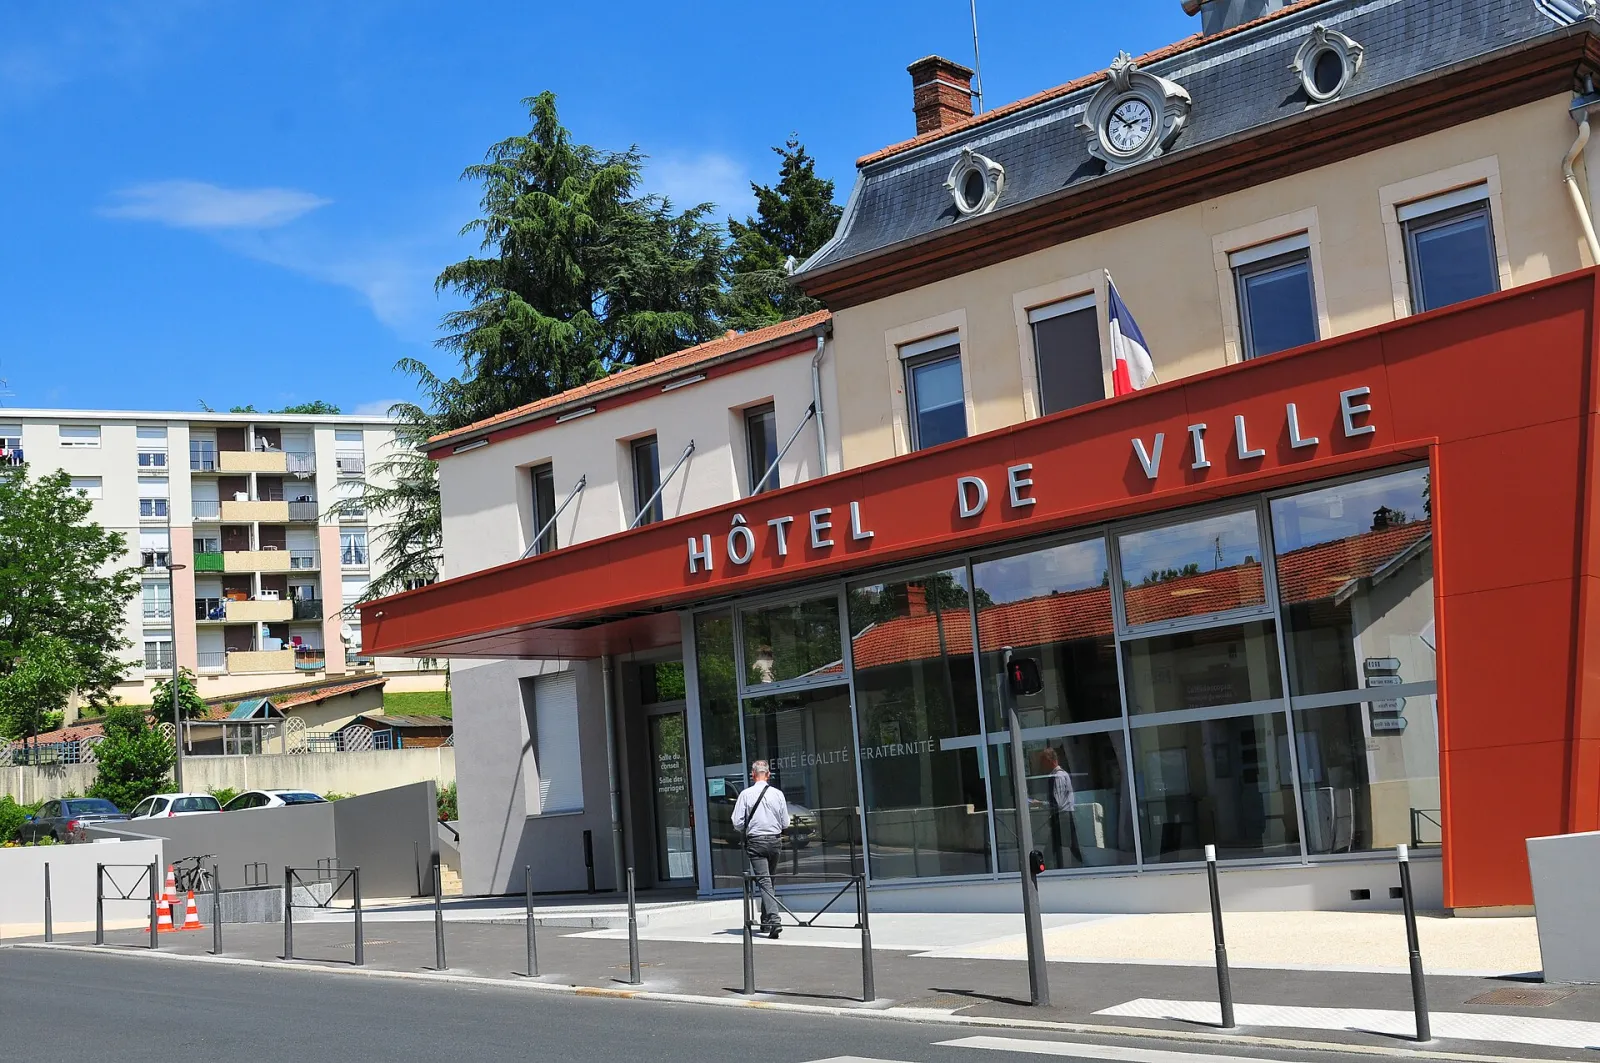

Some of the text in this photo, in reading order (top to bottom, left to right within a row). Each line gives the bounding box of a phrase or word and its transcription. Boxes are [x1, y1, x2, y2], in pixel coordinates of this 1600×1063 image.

[687, 386, 1376, 574] HÔTEL DE VILLE
[800, 745, 849, 767] ÉGALITÉ
[860, 736, 935, 760] FRATERNITÉ
[658, 753, 672, 761] Salle
[660, 761, 680, 770] conseil
[658, 776, 672, 784] Salle
[658, 785, 685, 793] mariages
